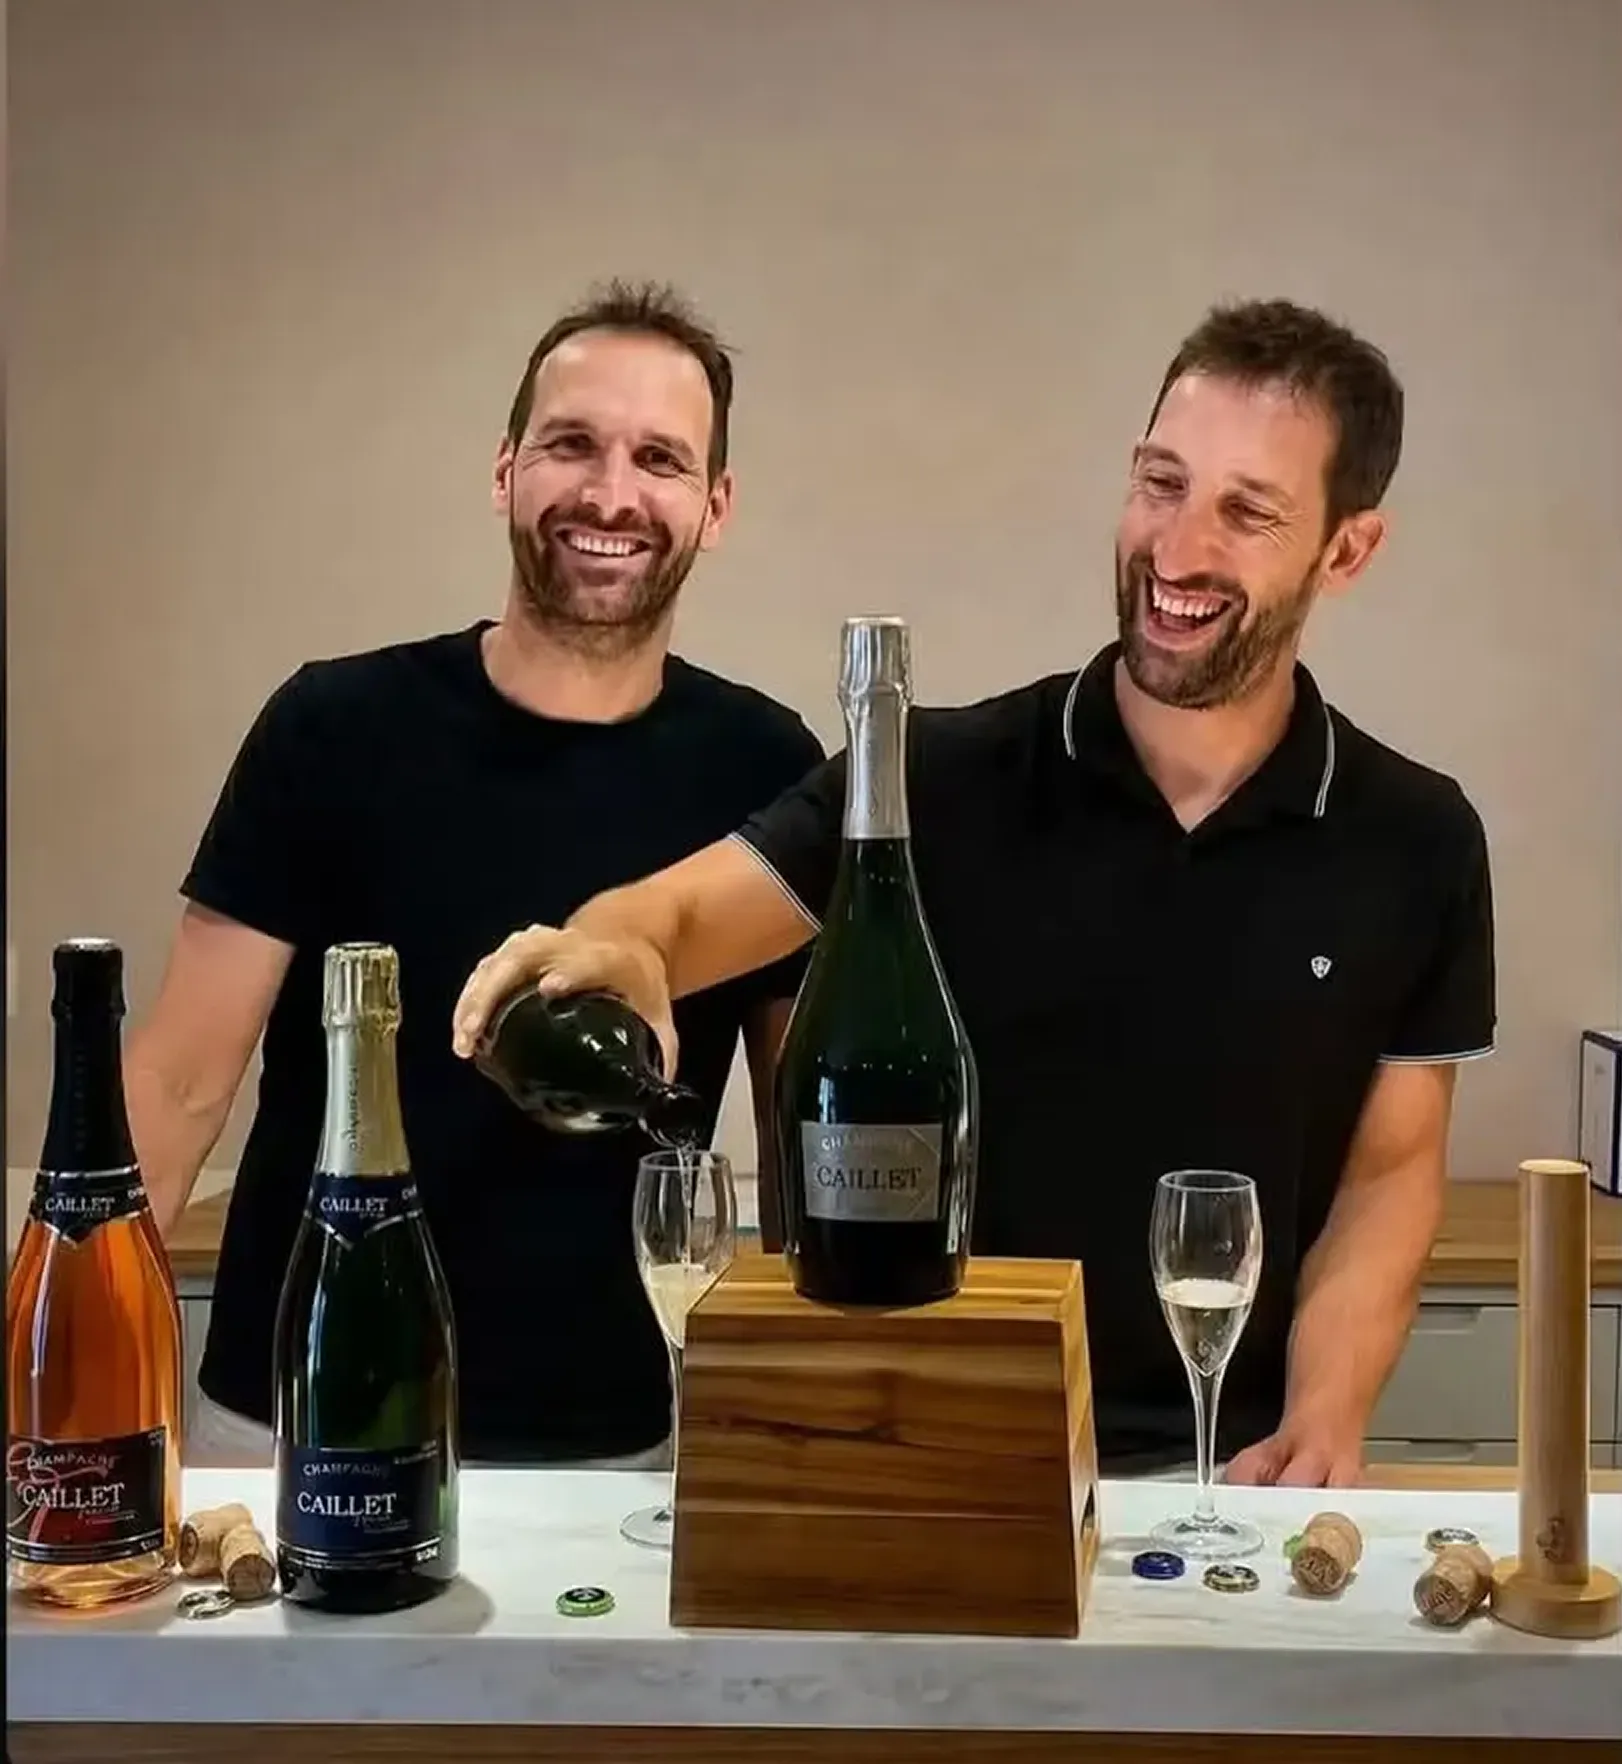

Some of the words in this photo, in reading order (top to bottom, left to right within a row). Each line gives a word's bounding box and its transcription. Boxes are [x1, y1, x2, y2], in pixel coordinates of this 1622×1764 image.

[816, 1165, 922, 1191] CAILLET
[45, 1197, 115, 1213] CAILLET
[320, 1197, 388, 1212] CAILLET
[22, 1482, 125, 1508] CAILLET
[297, 1491, 397, 1516] CAILLET
